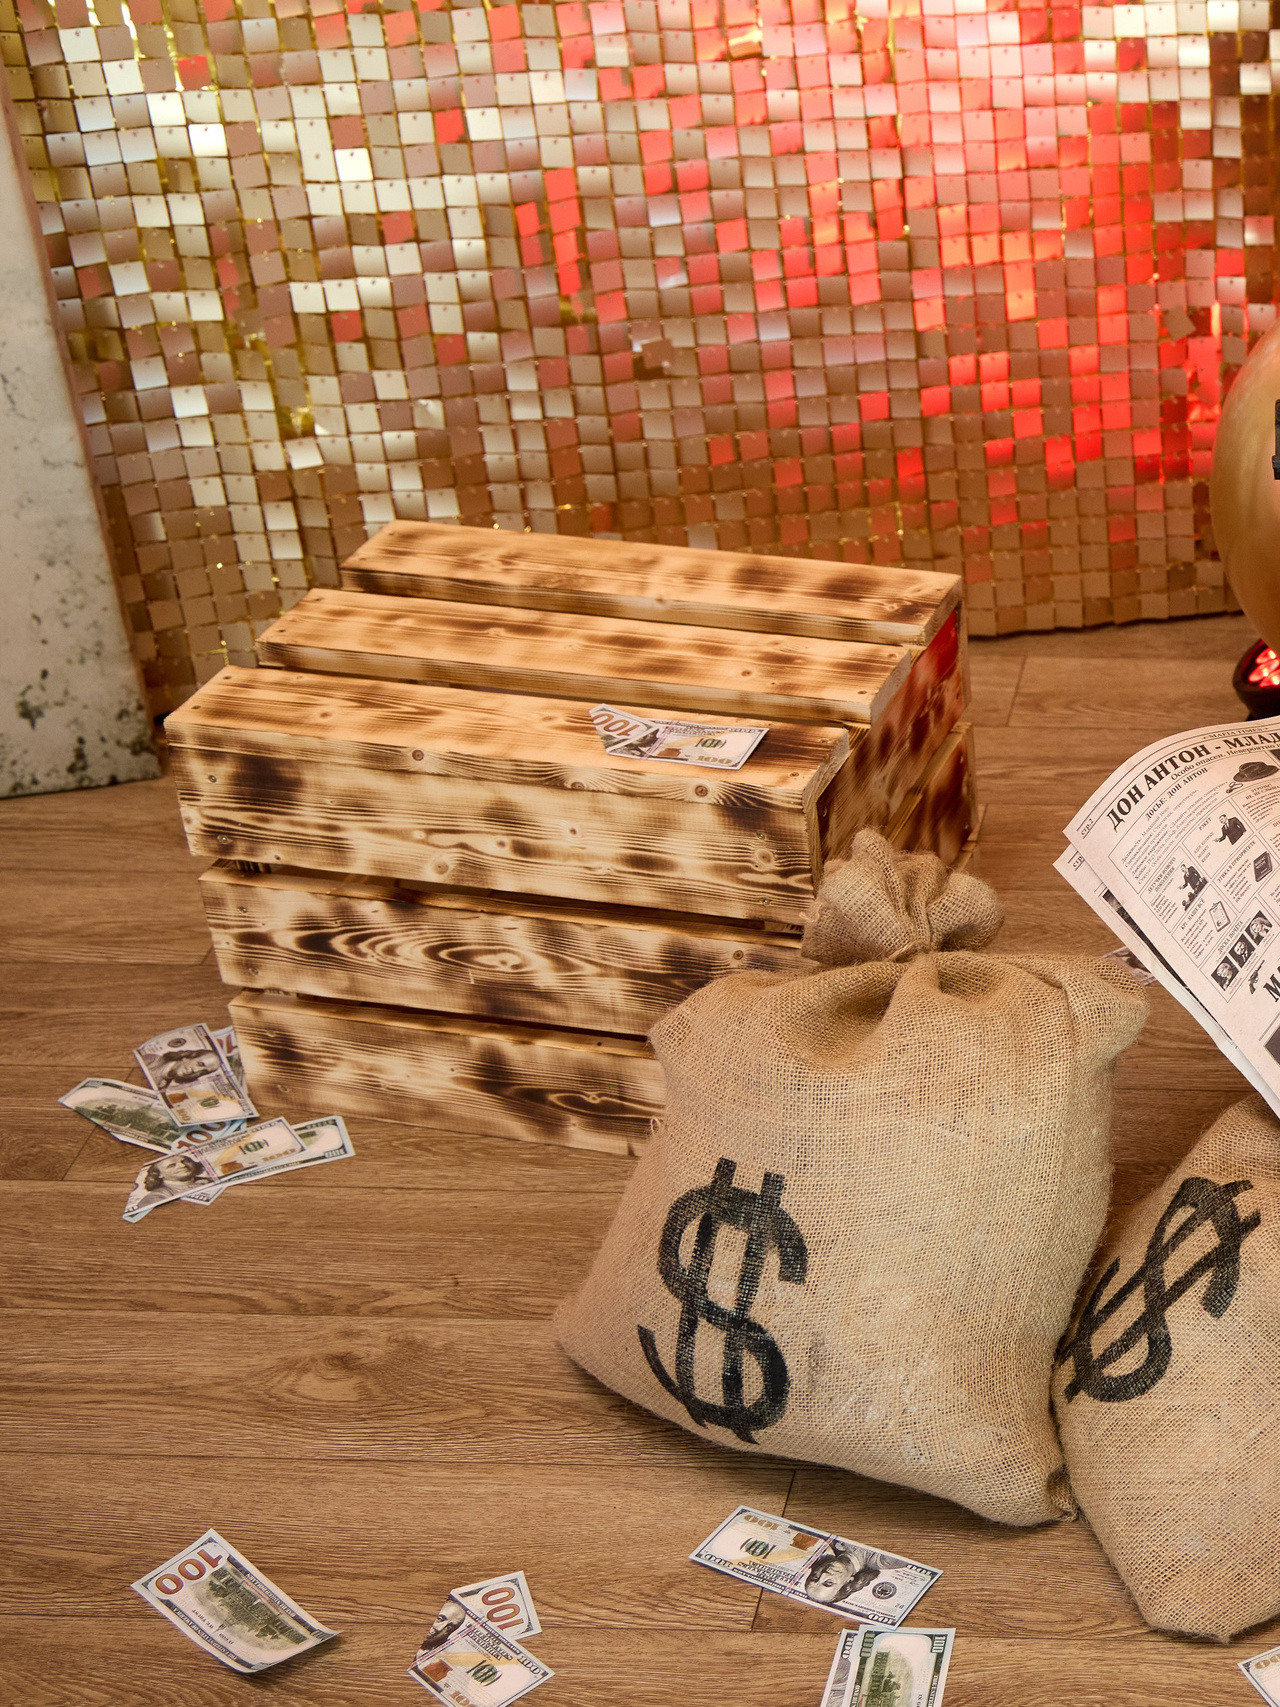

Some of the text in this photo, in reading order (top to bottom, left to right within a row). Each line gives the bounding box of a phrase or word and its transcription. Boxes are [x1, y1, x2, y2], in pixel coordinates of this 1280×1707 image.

[1170, 761, 1195, 781] Особо
[1195, 753, 1229, 768] опасен.
[1226, 745, 1279, 756] Невероятно
[1107, 790, 1144, 831] ДОН
[1143, 744, 1209, 791] АНТОН
[1143, 765, 1209, 821] ДОСЬЕ: ДОН АНТОН
[1197, 817, 1212, 831] РЭКЕТ
[1231, 840, 1256, 867] ПРИОРИТЕТЕ
[741, 1512, 780, 1531] 100
[155, 1549, 223, 1595] 100
[701, 1552, 734, 1568] 100
[481, 1587, 518, 1634] 100
[865, 1610, 897, 1626] 100
[517, 1653, 541, 1676] 100
